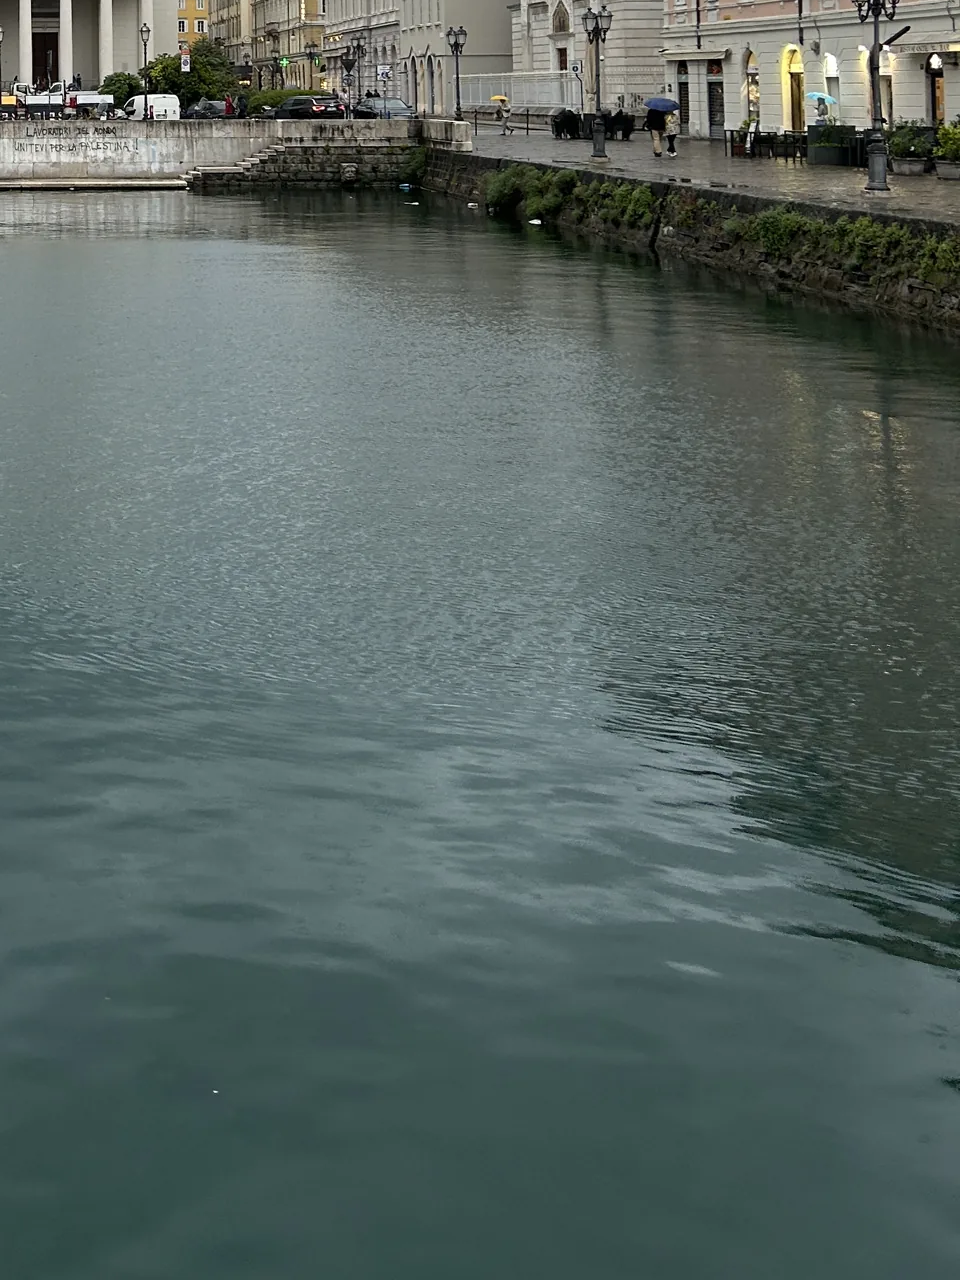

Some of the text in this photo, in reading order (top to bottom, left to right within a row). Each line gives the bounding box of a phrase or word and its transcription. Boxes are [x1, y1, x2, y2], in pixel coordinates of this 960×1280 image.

[26, 126, 71, 137] LAVORATORI
[14, 141, 48, 152] UNITEVI
[50, 143, 65, 152] PER
[68, 142, 77, 151] LA
[80, 141, 131, 152] PALESTINA
